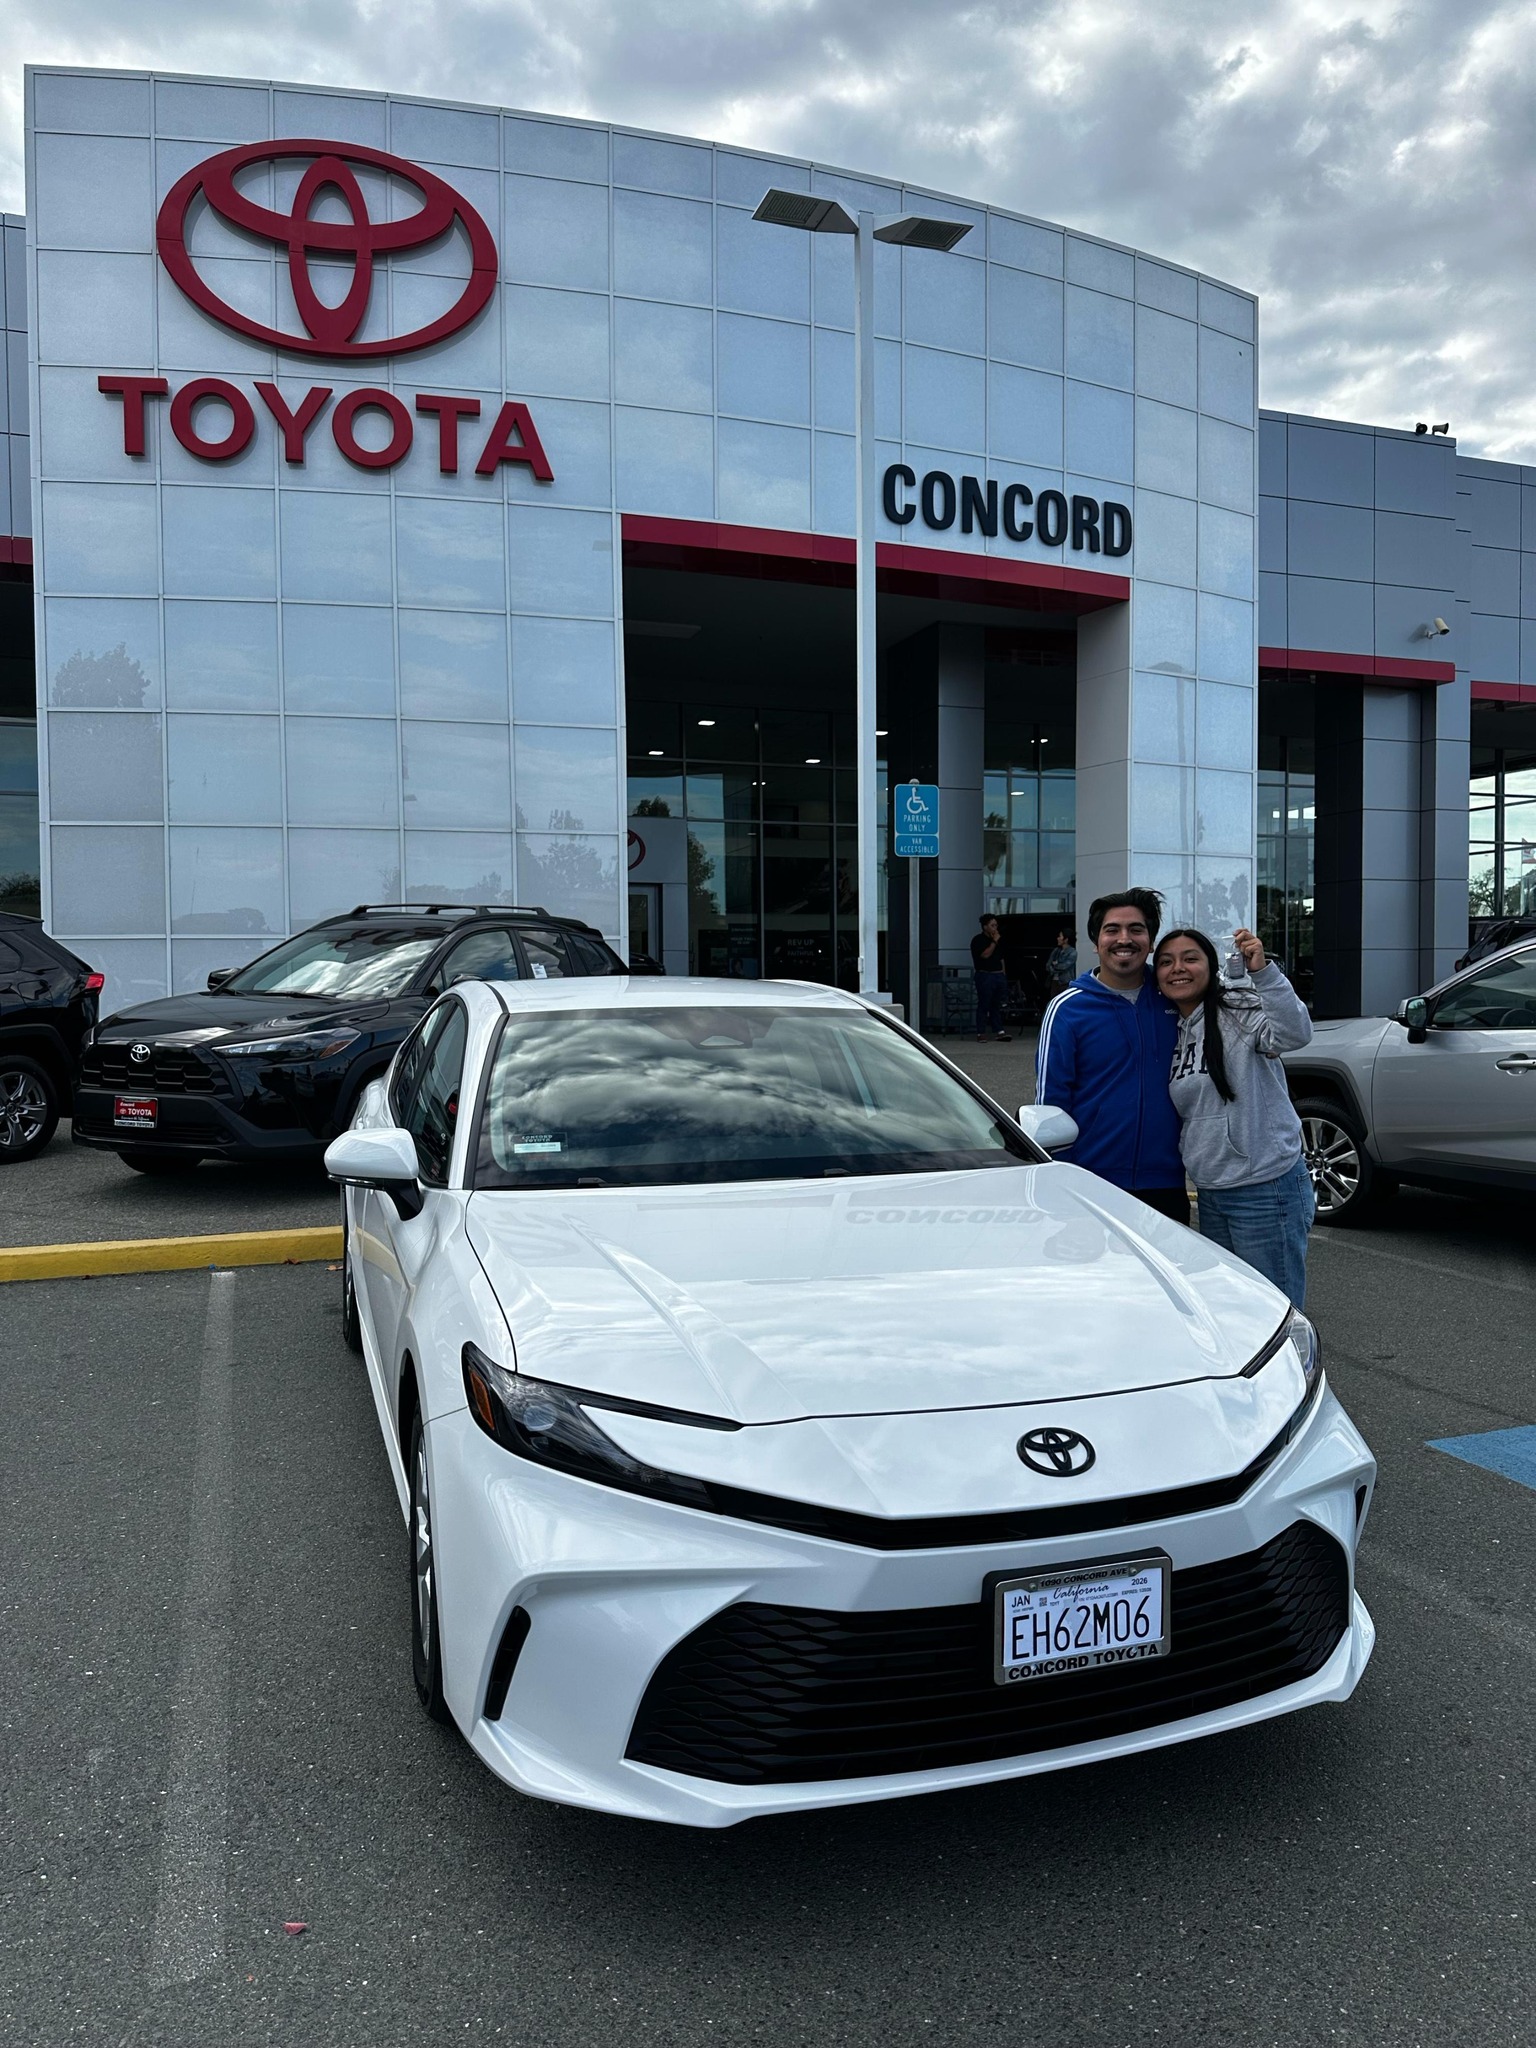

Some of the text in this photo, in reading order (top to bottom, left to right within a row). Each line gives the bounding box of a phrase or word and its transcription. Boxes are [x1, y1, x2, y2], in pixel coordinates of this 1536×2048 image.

[98, 376, 554, 482] TOYOTA
[883, 464, 1132, 557] CONCORD
[903, 814, 931, 823] PARKING
[909, 823, 926, 832] ONLY
[911, 837, 922, 845] VAN
[900, 845, 934, 853] ACCESSIBLE
[787, 938, 815, 946] REV UP
[1063, 1571, 1108, 1584] CONCORD
[1109, 1567, 1128, 1577] AVE
[1131, 1577, 1148, 1586] 2026
[1053, 1582, 1110, 1603] California
[1011, 1594, 1031, 1608] JAN
[1012, 1595, 1150, 1660] EH62M06
[1008, 1643, 1159, 1680] CONCORD TOYOTA
